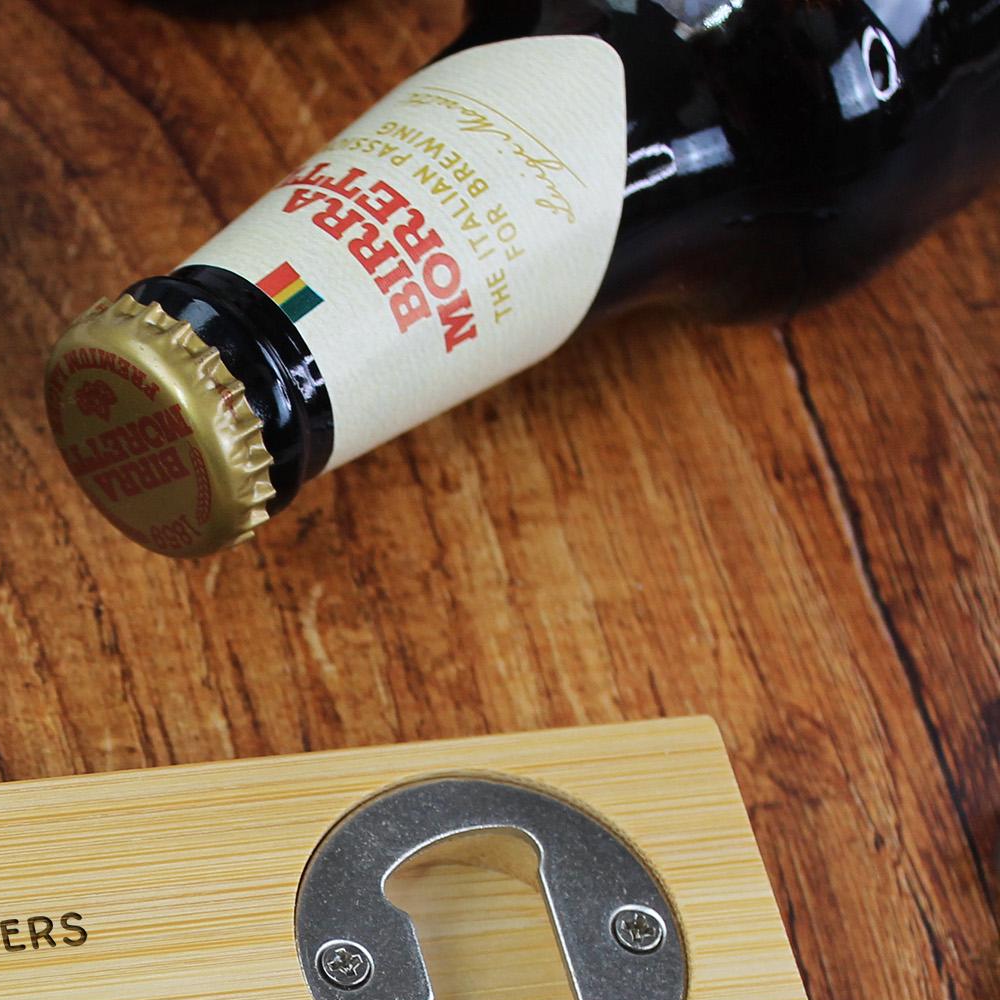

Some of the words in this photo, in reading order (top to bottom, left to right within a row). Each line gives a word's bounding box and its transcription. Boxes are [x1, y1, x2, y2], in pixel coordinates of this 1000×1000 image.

[375, 120, 489, 199] BREWING
[411, 164, 493, 262] ITALIAN
[486, 202, 525, 262] FOR
[281, 187, 433, 335] BIRRA
[485, 268, 512, 324] THE
[93, 446, 191, 502] BIRRA
